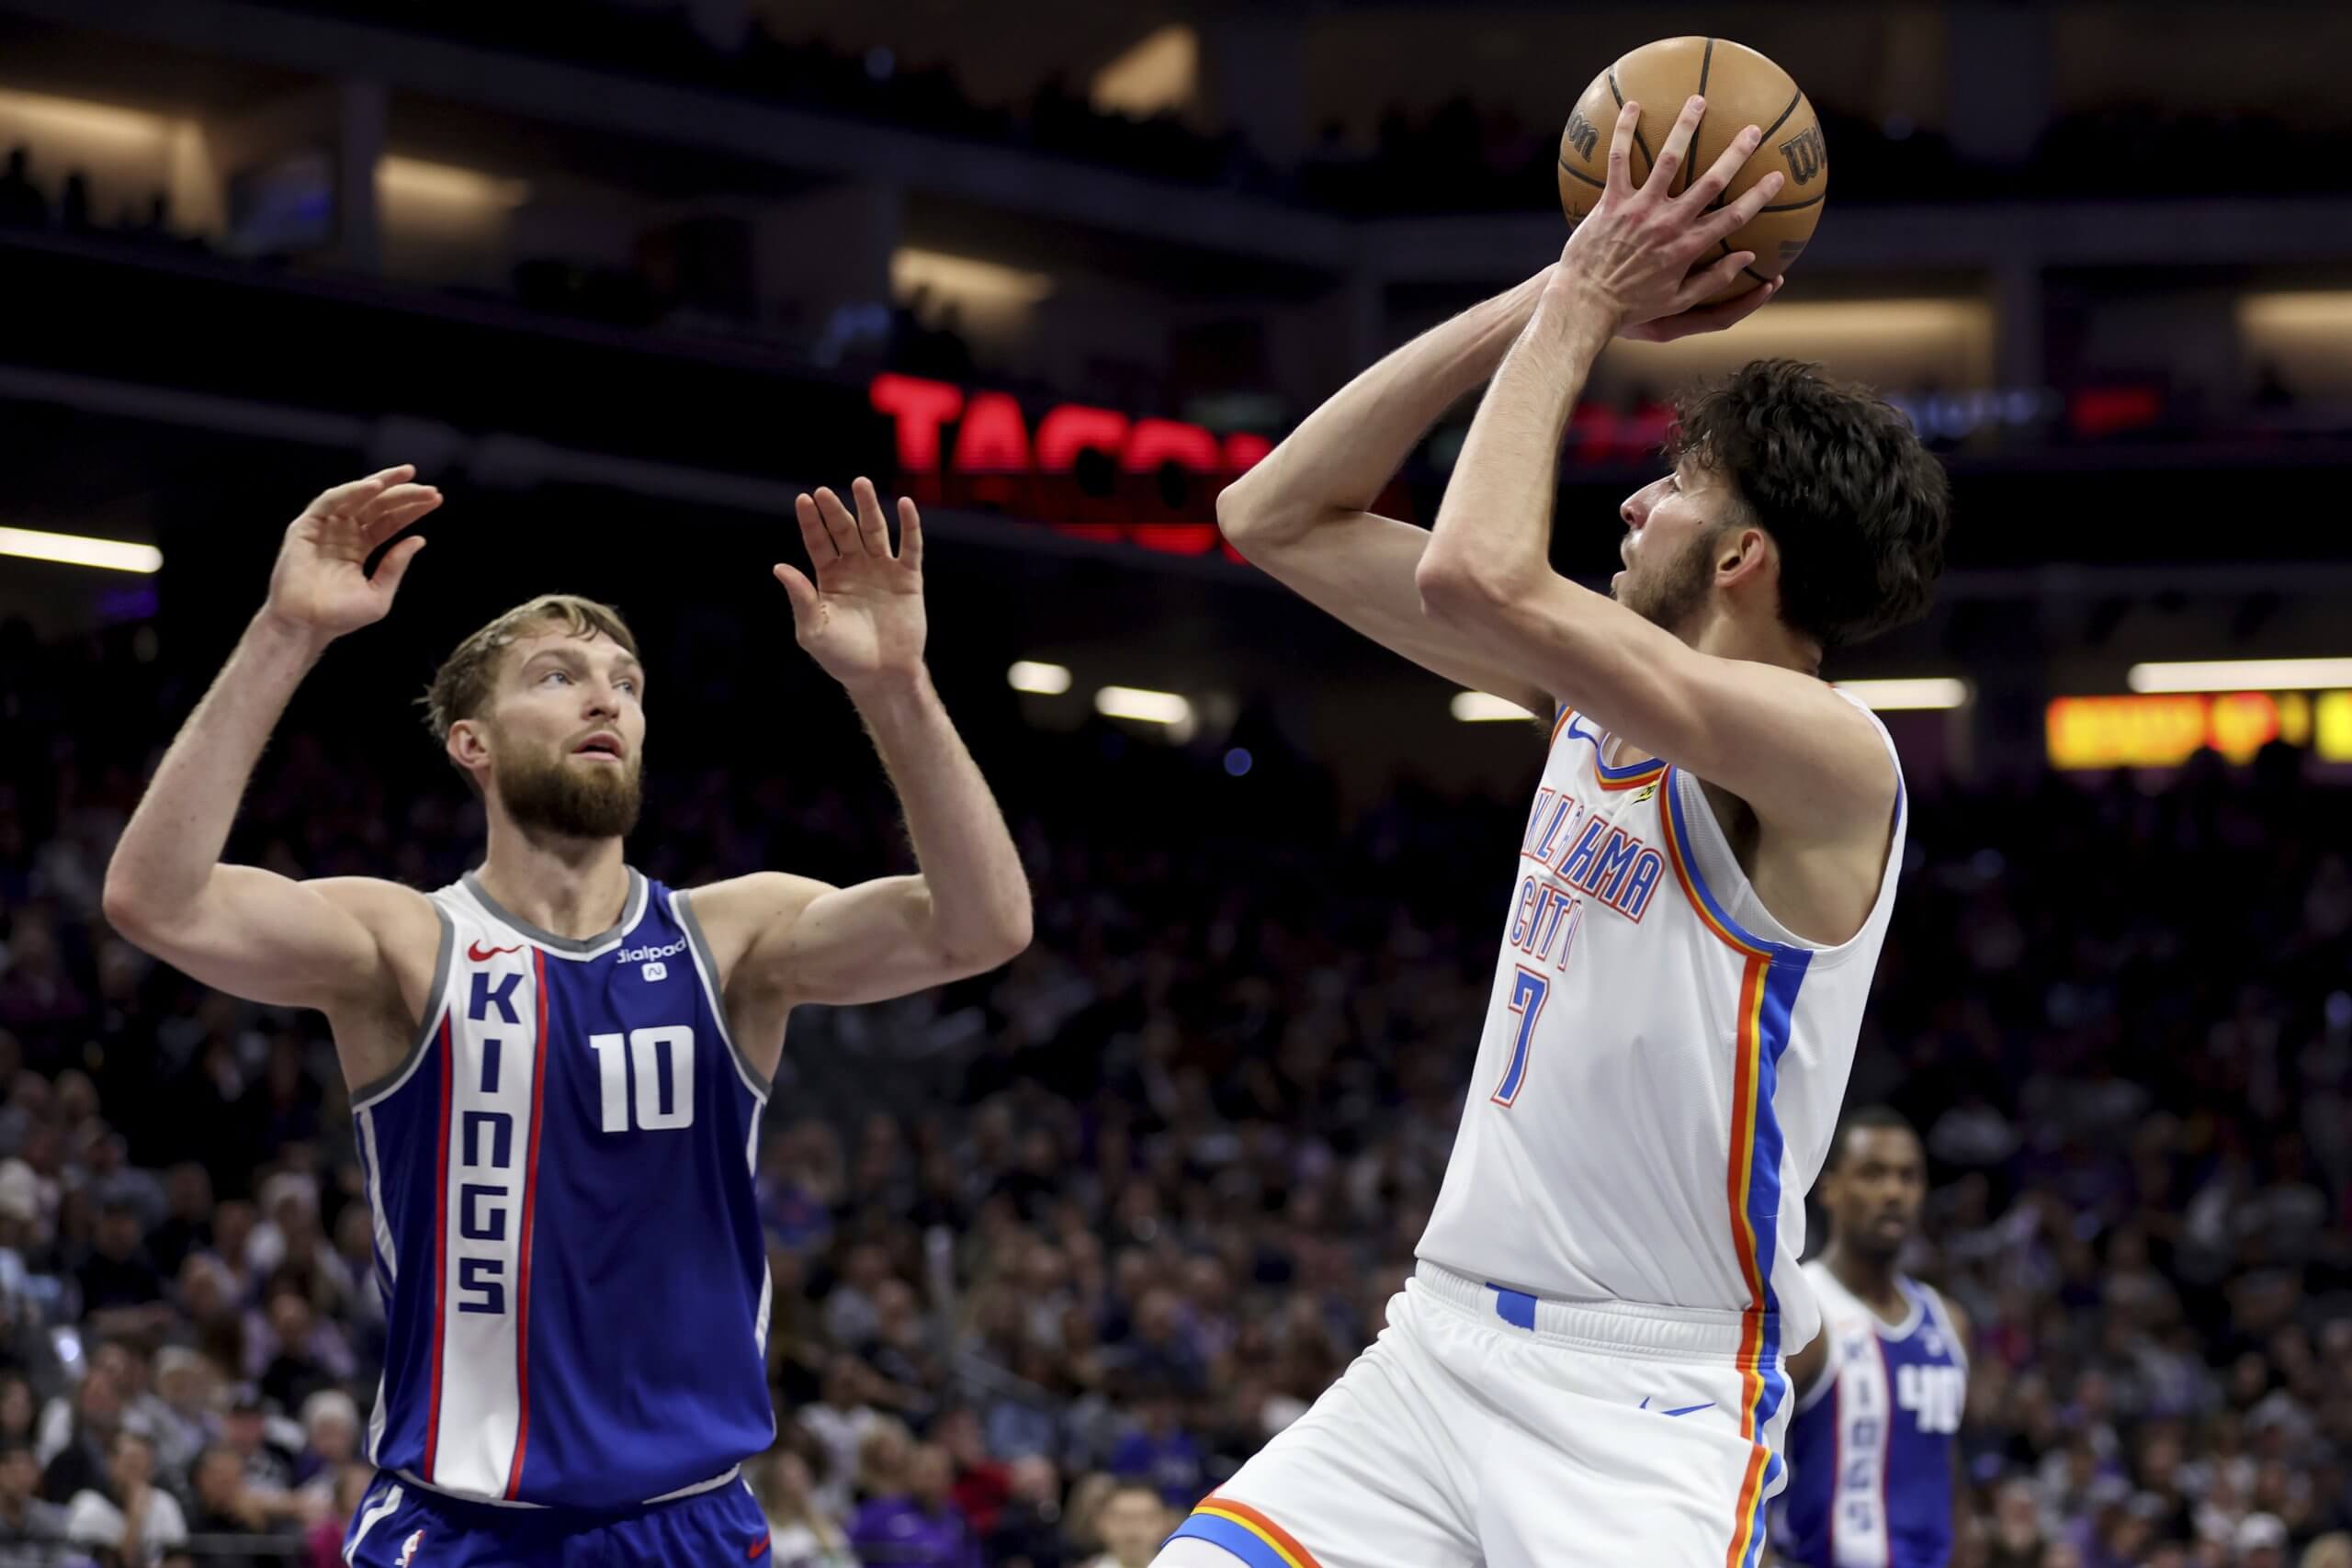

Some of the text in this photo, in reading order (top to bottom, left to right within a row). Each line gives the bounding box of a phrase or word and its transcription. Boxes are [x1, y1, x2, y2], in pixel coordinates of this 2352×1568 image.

[869, 371, 1273, 566] TACO
[616, 936, 687, 964] dialpad
[589, 1025, 695, 1133] 10
[1490, 963, 1550, 1109] 7
[458, 972, 525, 1315] KINGS
